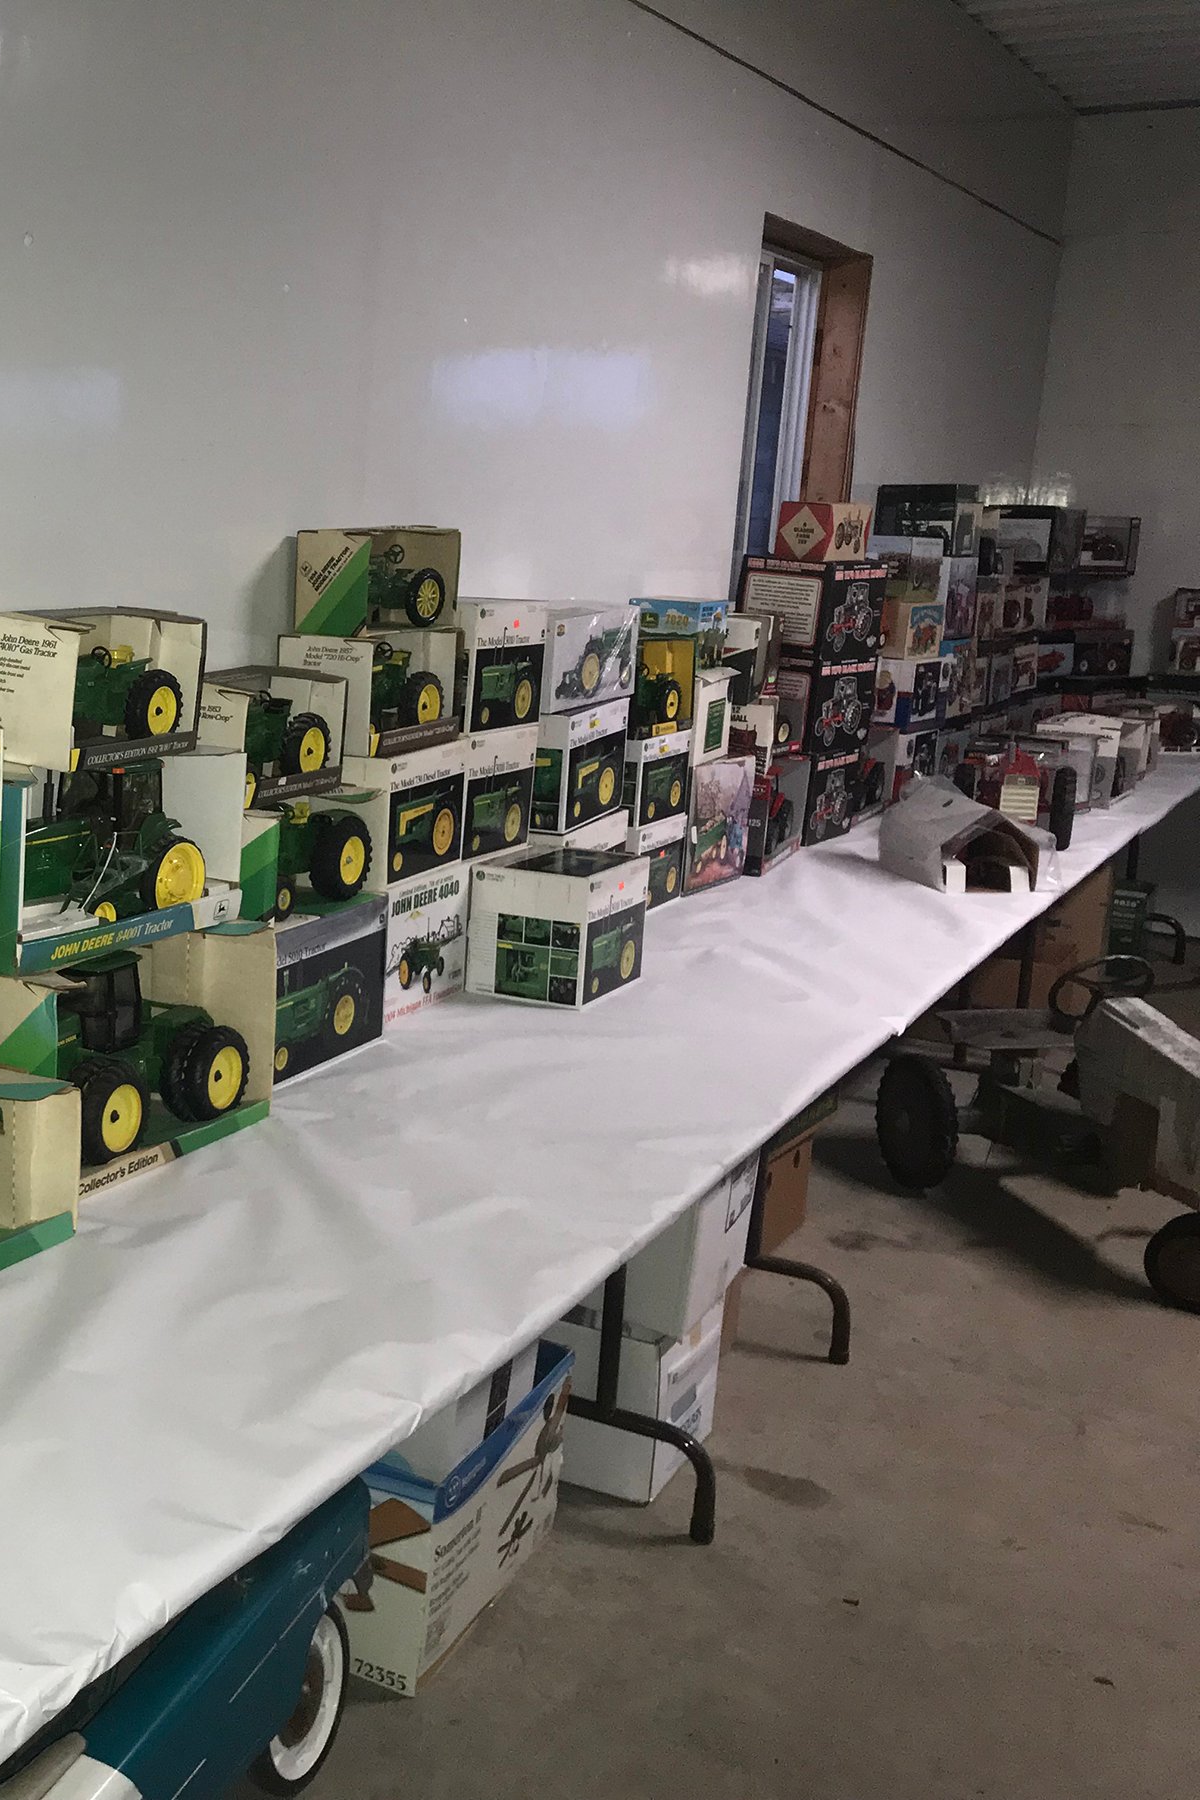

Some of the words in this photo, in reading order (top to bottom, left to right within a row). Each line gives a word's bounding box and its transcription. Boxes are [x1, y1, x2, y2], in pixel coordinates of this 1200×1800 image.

[1, 634, 17, 643] John
[18, 636, 40, 646] Deere
[20, 645, 33, 654] Gas
[34, 647, 57, 658] Tractor
[390, 781, 400, 791] The
[401, 777, 415, 788] Model
[437, 768, 451, 779] Tractor
[469, 767, 478, 778] The
[506, 760, 520, 770] Tractor
[391, 895, 412, 917] JOHN
[413, 887, 438, 909] DEERE
[438, 880, 460, 899] 4040
[50, 941, 81, 960] JOHN
[81, 932, 115, 952] DEERE
[144, 919, 174, 935] Tractor
[79, 1166, 126, 1196] Collector's
[127, 1153, 159, 1175] Edition
[354, 1658, 407, 1691] 72355
